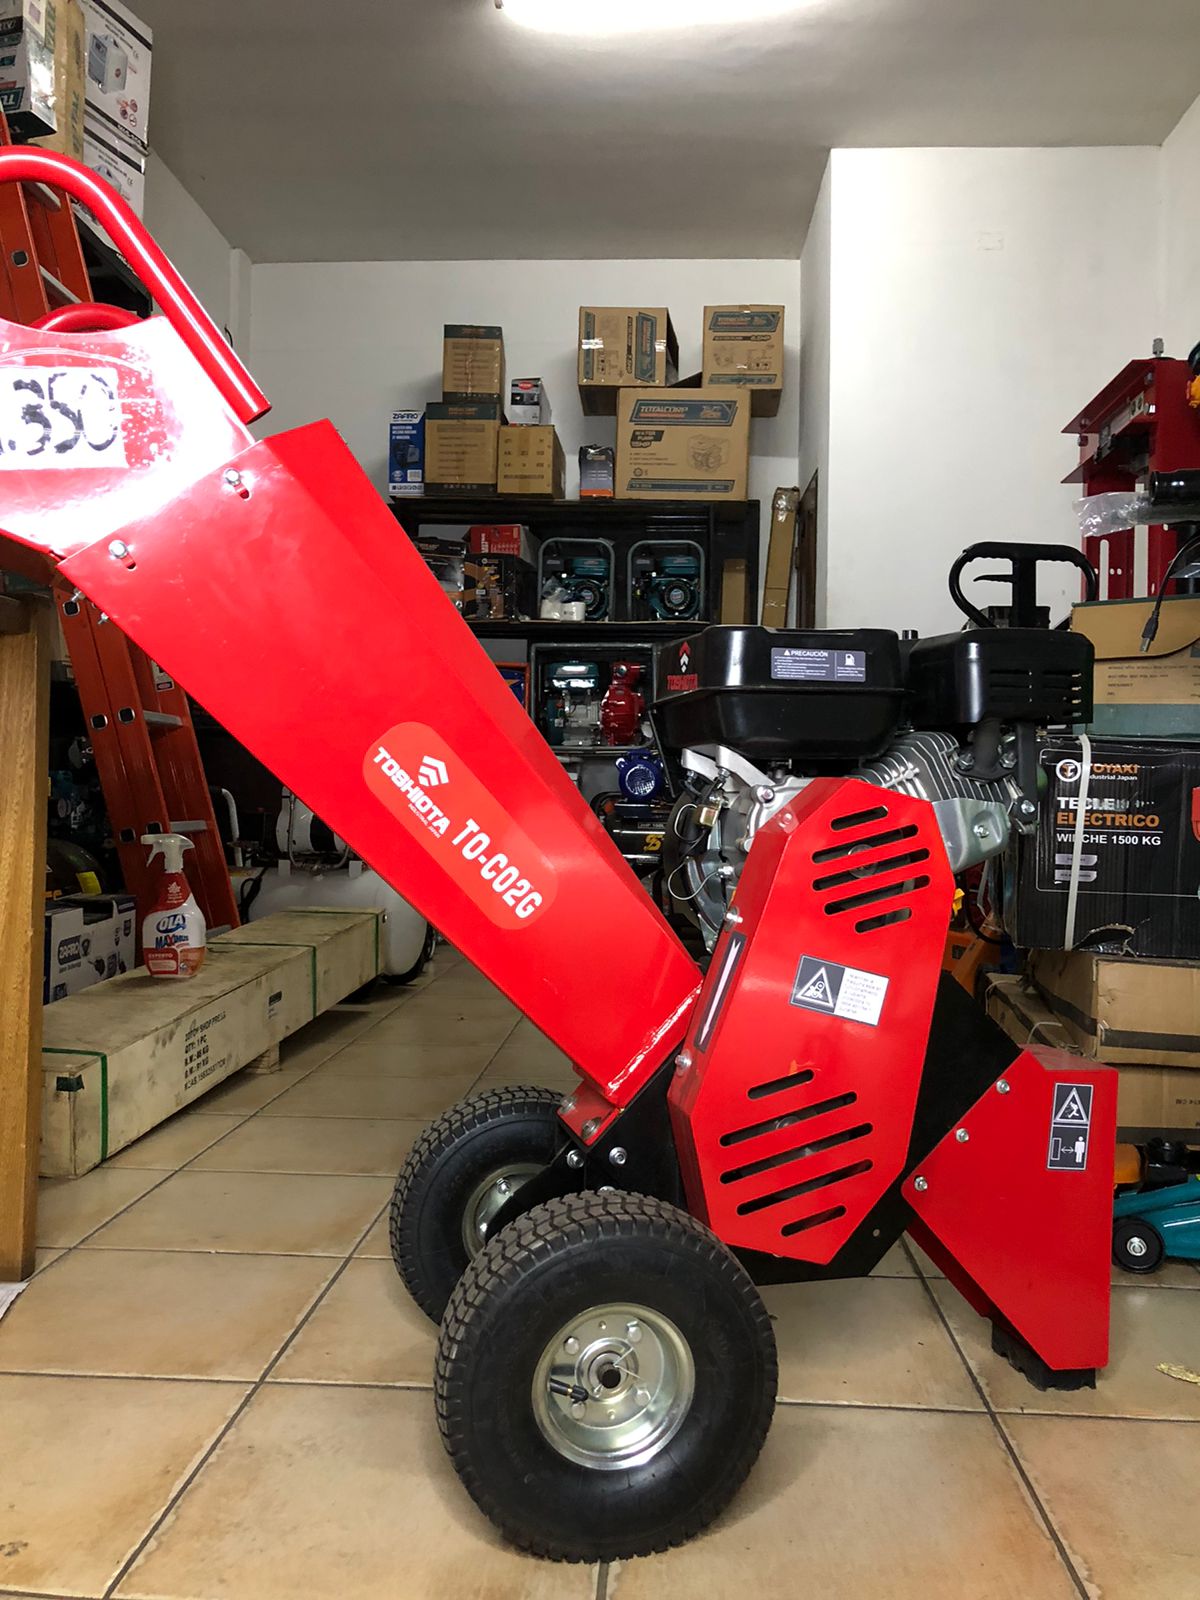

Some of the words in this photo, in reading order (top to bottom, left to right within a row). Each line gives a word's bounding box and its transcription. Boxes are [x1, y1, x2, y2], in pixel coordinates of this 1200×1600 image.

[0, 372, 118, 456] .350
[1056, 833, 1108, 845] WICHE
[1111, 835, 1139, 846] 1500
[1142, 836, 1162, 846] KG
[158, 914, 184, 930] OLA
